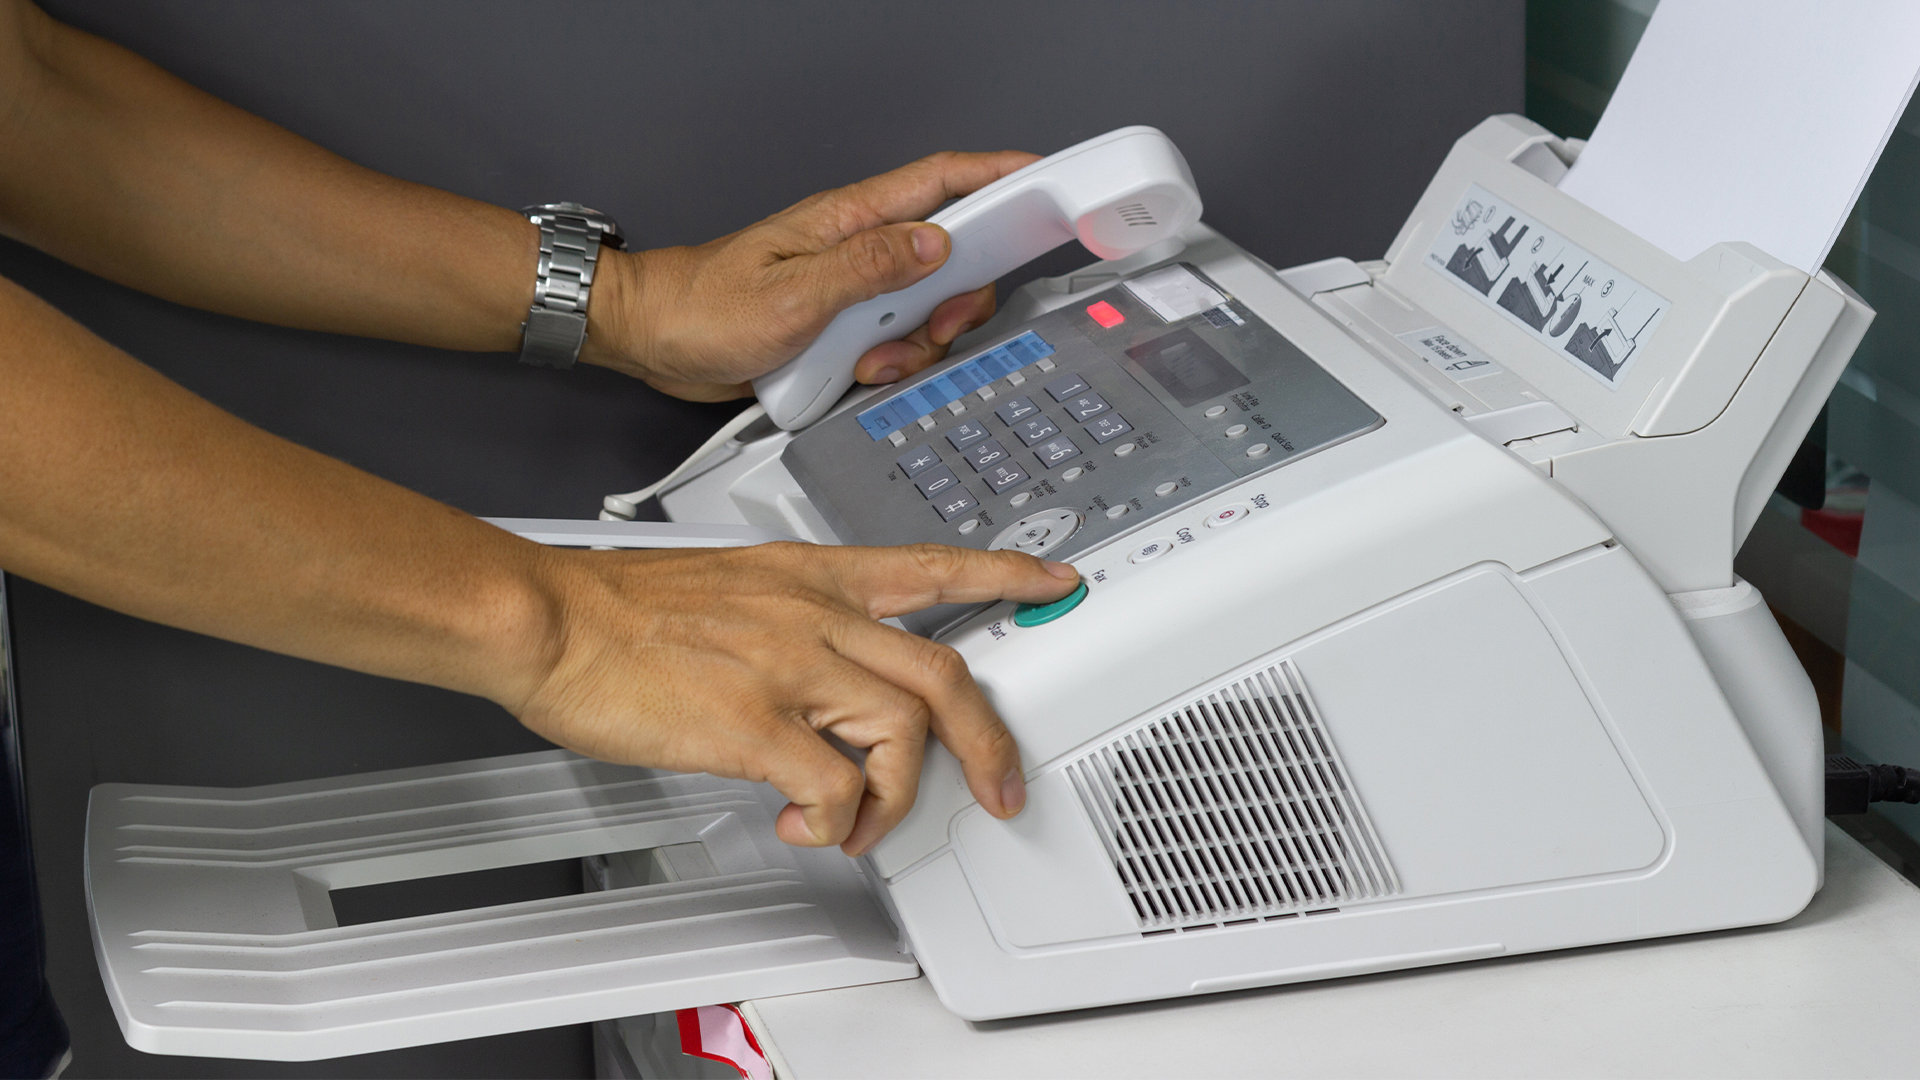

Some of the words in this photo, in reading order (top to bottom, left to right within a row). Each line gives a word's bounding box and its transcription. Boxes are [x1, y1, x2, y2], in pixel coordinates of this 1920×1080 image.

[1532, 237, 1543, 252] 2
[1583, 275, 1595, 287] MAX
[1602, 281, 1613, 296] 3
[1432, 335, 1450, 345] Face
[1446, 345, 1467, 357] down
[1062, 384, 1081, 394] 1
[1248, 398, 1259, 407] Fax
[1012, 407, 1031, 417] 4
[1081, 404, 1102, 416] 2
[1251, 414, 1265, 425] Caller
[961, 430, 981, 441] 7
[1030, 427, 1052, 438] 5
[1102, 424, 1122, 436] 3
[1271, 433, 1287, 444] Quick
[1281, 441, 1294, 452] Scan
[979, 452, 1000, 464] 8
[1050, 449, 1071, 460] 6
[928, 478, 949, 491] 0
[997, 473, 1018, 484] 9
[1178, 476, 1191, 487] Help
[1031, 485, 1045, 498] Mute
[1039, 478, 1057, 495] Handset
[945, 499, 968, 513] #
[1092, 494, 1110, 511] Volume
[1128, 497, 1143, 510] Menu
[1250, 493, 1270, 509] Stop
[978, 510, 994, 527] Monitor
[1176, 527, 1195, 544] Copy
[1092, 569, 1107, 583] Fax
[988, 622, 1007, 640] Start
